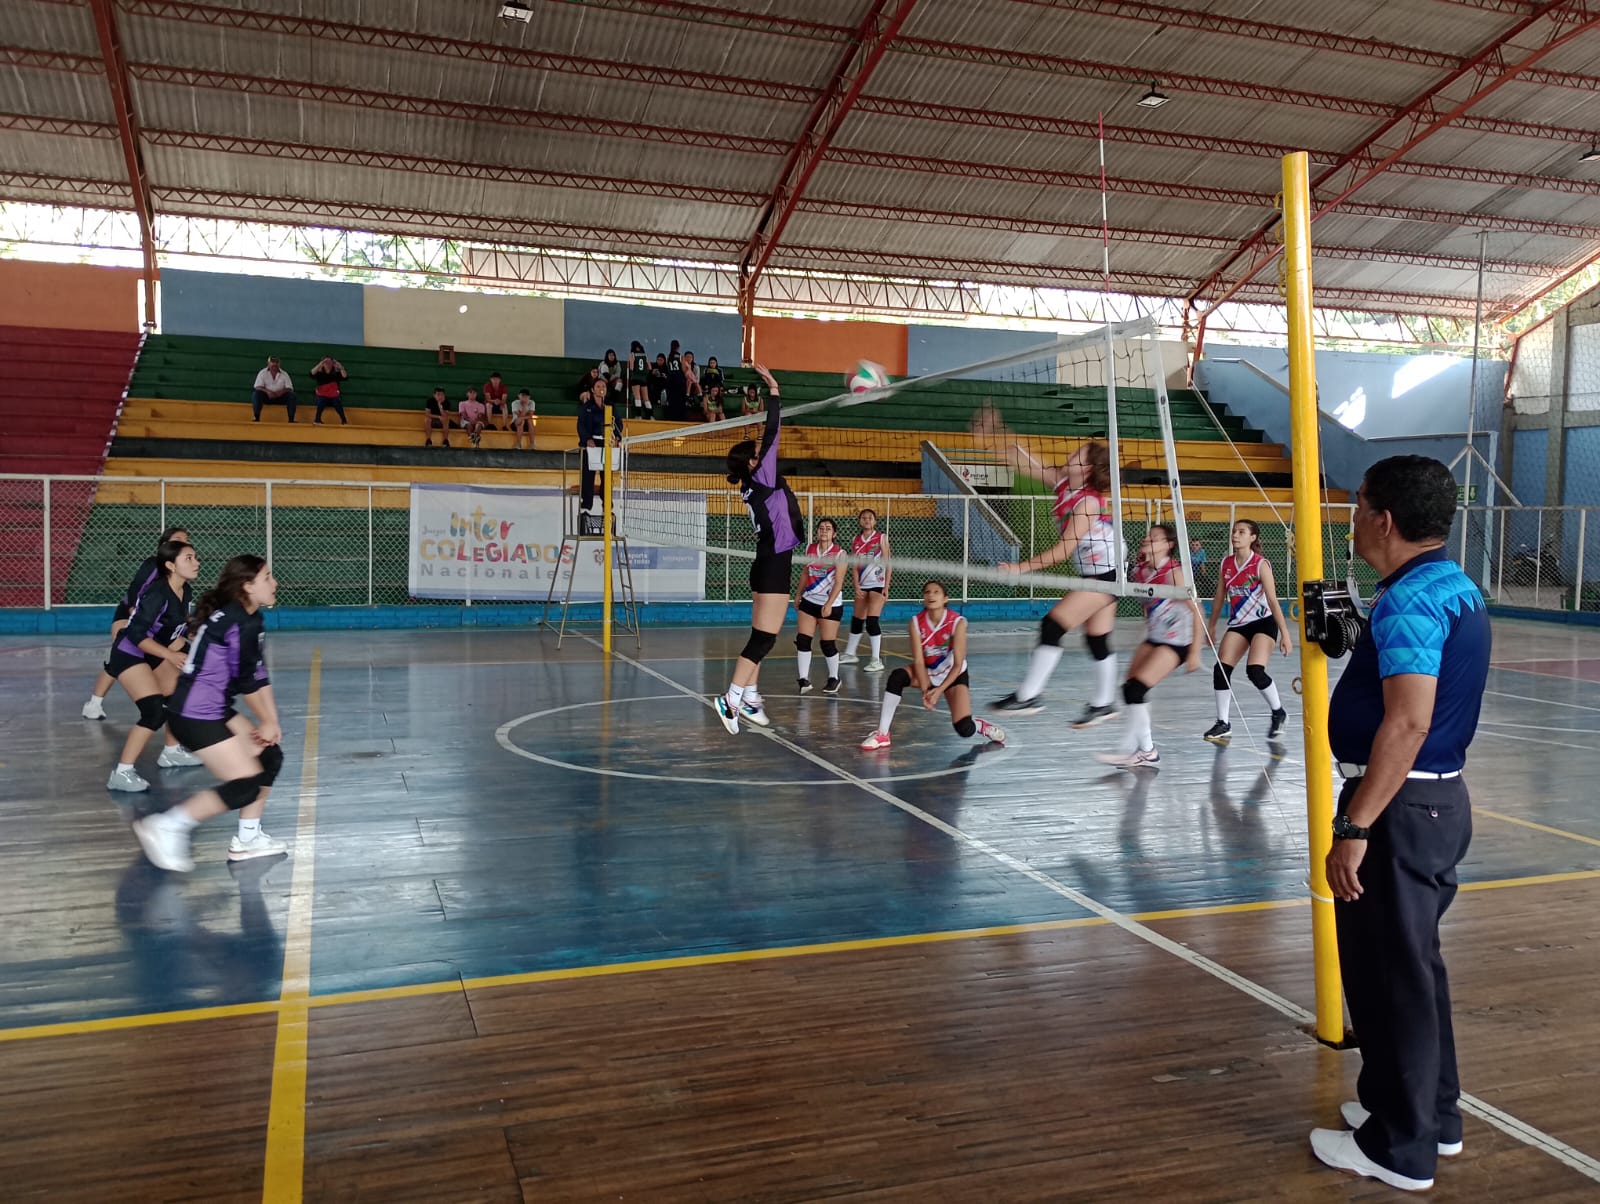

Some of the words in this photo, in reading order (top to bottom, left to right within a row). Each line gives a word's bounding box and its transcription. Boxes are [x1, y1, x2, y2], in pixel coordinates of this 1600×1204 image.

[638, 358, 644, 371] 9
[450, 504, 515, 543] Inter
[420, 539, 575, 565] COLEGIADOS
[420, 563, 572, 580] Nacionales
